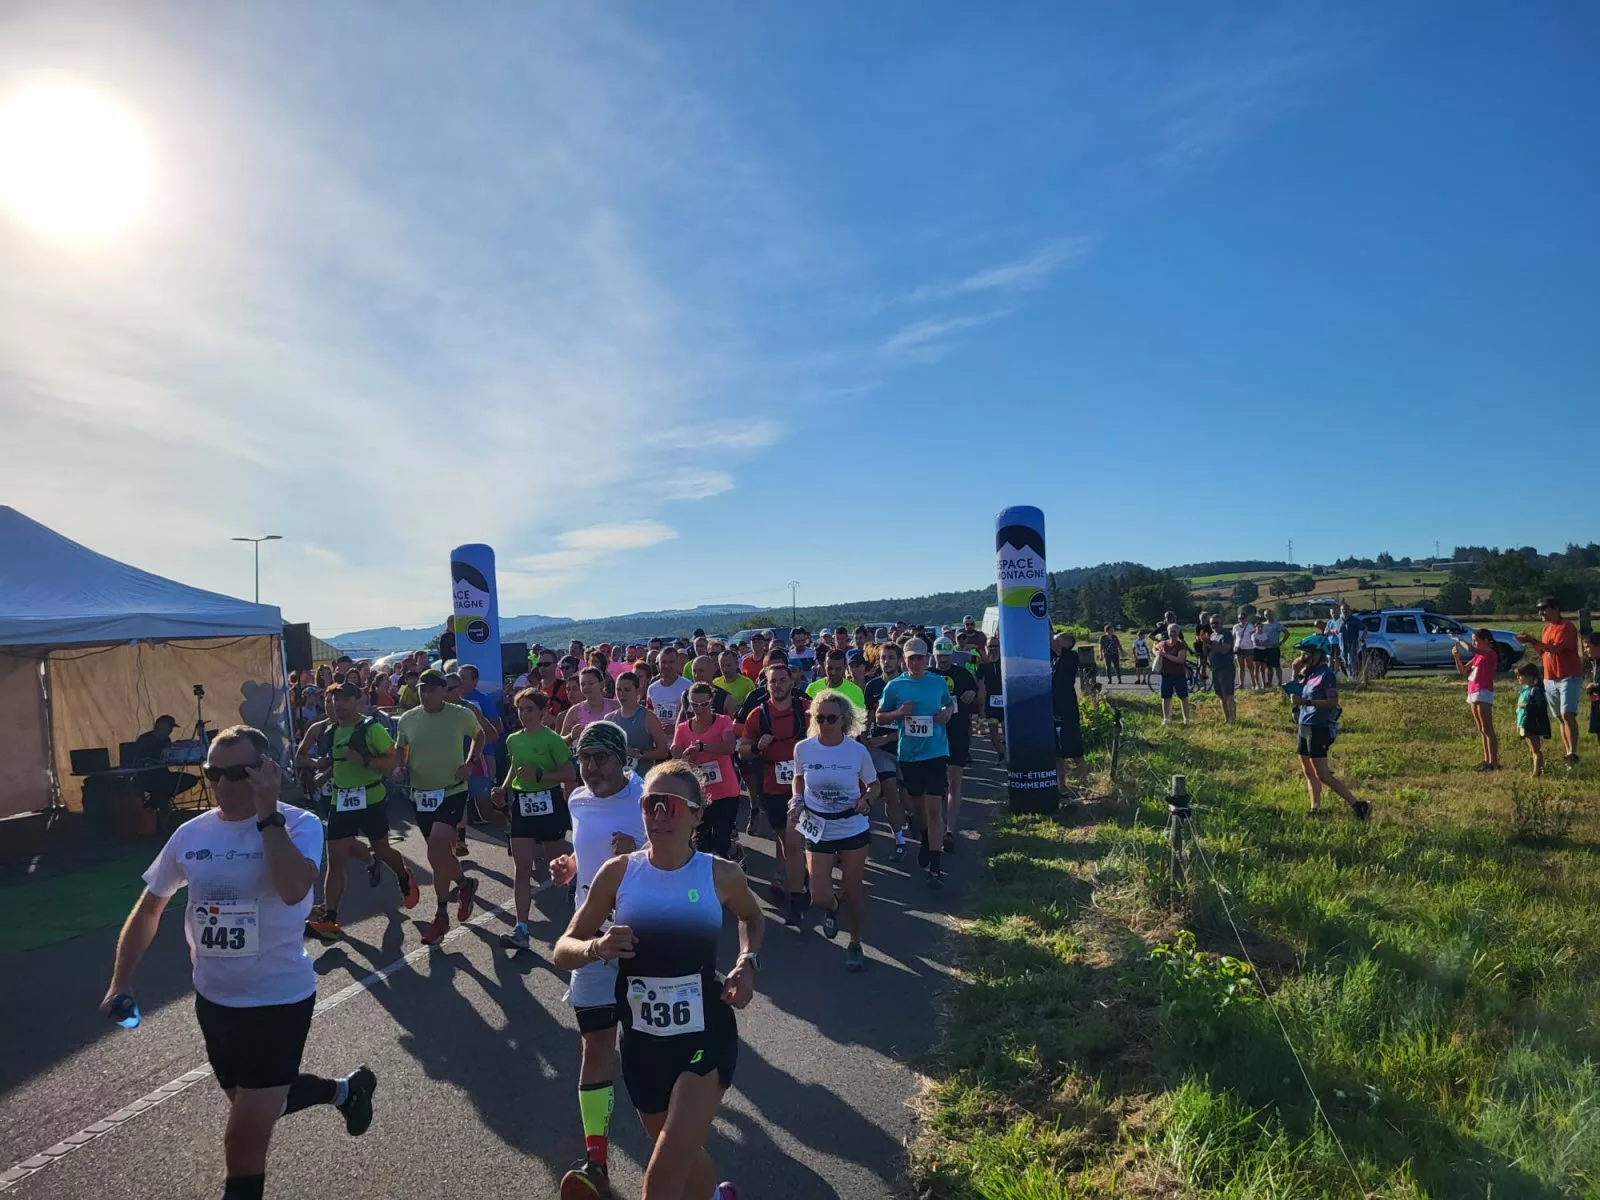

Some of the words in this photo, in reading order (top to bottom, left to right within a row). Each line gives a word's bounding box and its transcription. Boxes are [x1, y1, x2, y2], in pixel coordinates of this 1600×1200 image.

[910, 724, 928, 734] 370
[780, 770, 794, 781] 43
[342, 796, 360, 807] 415
[421, 797, 438, 808] 447
[525, 801, 548, 813] 353
[802, 818, 819, 838] 435
[201, 926, 246, 950] 443
[641, 1000, 691, 1028] 436
